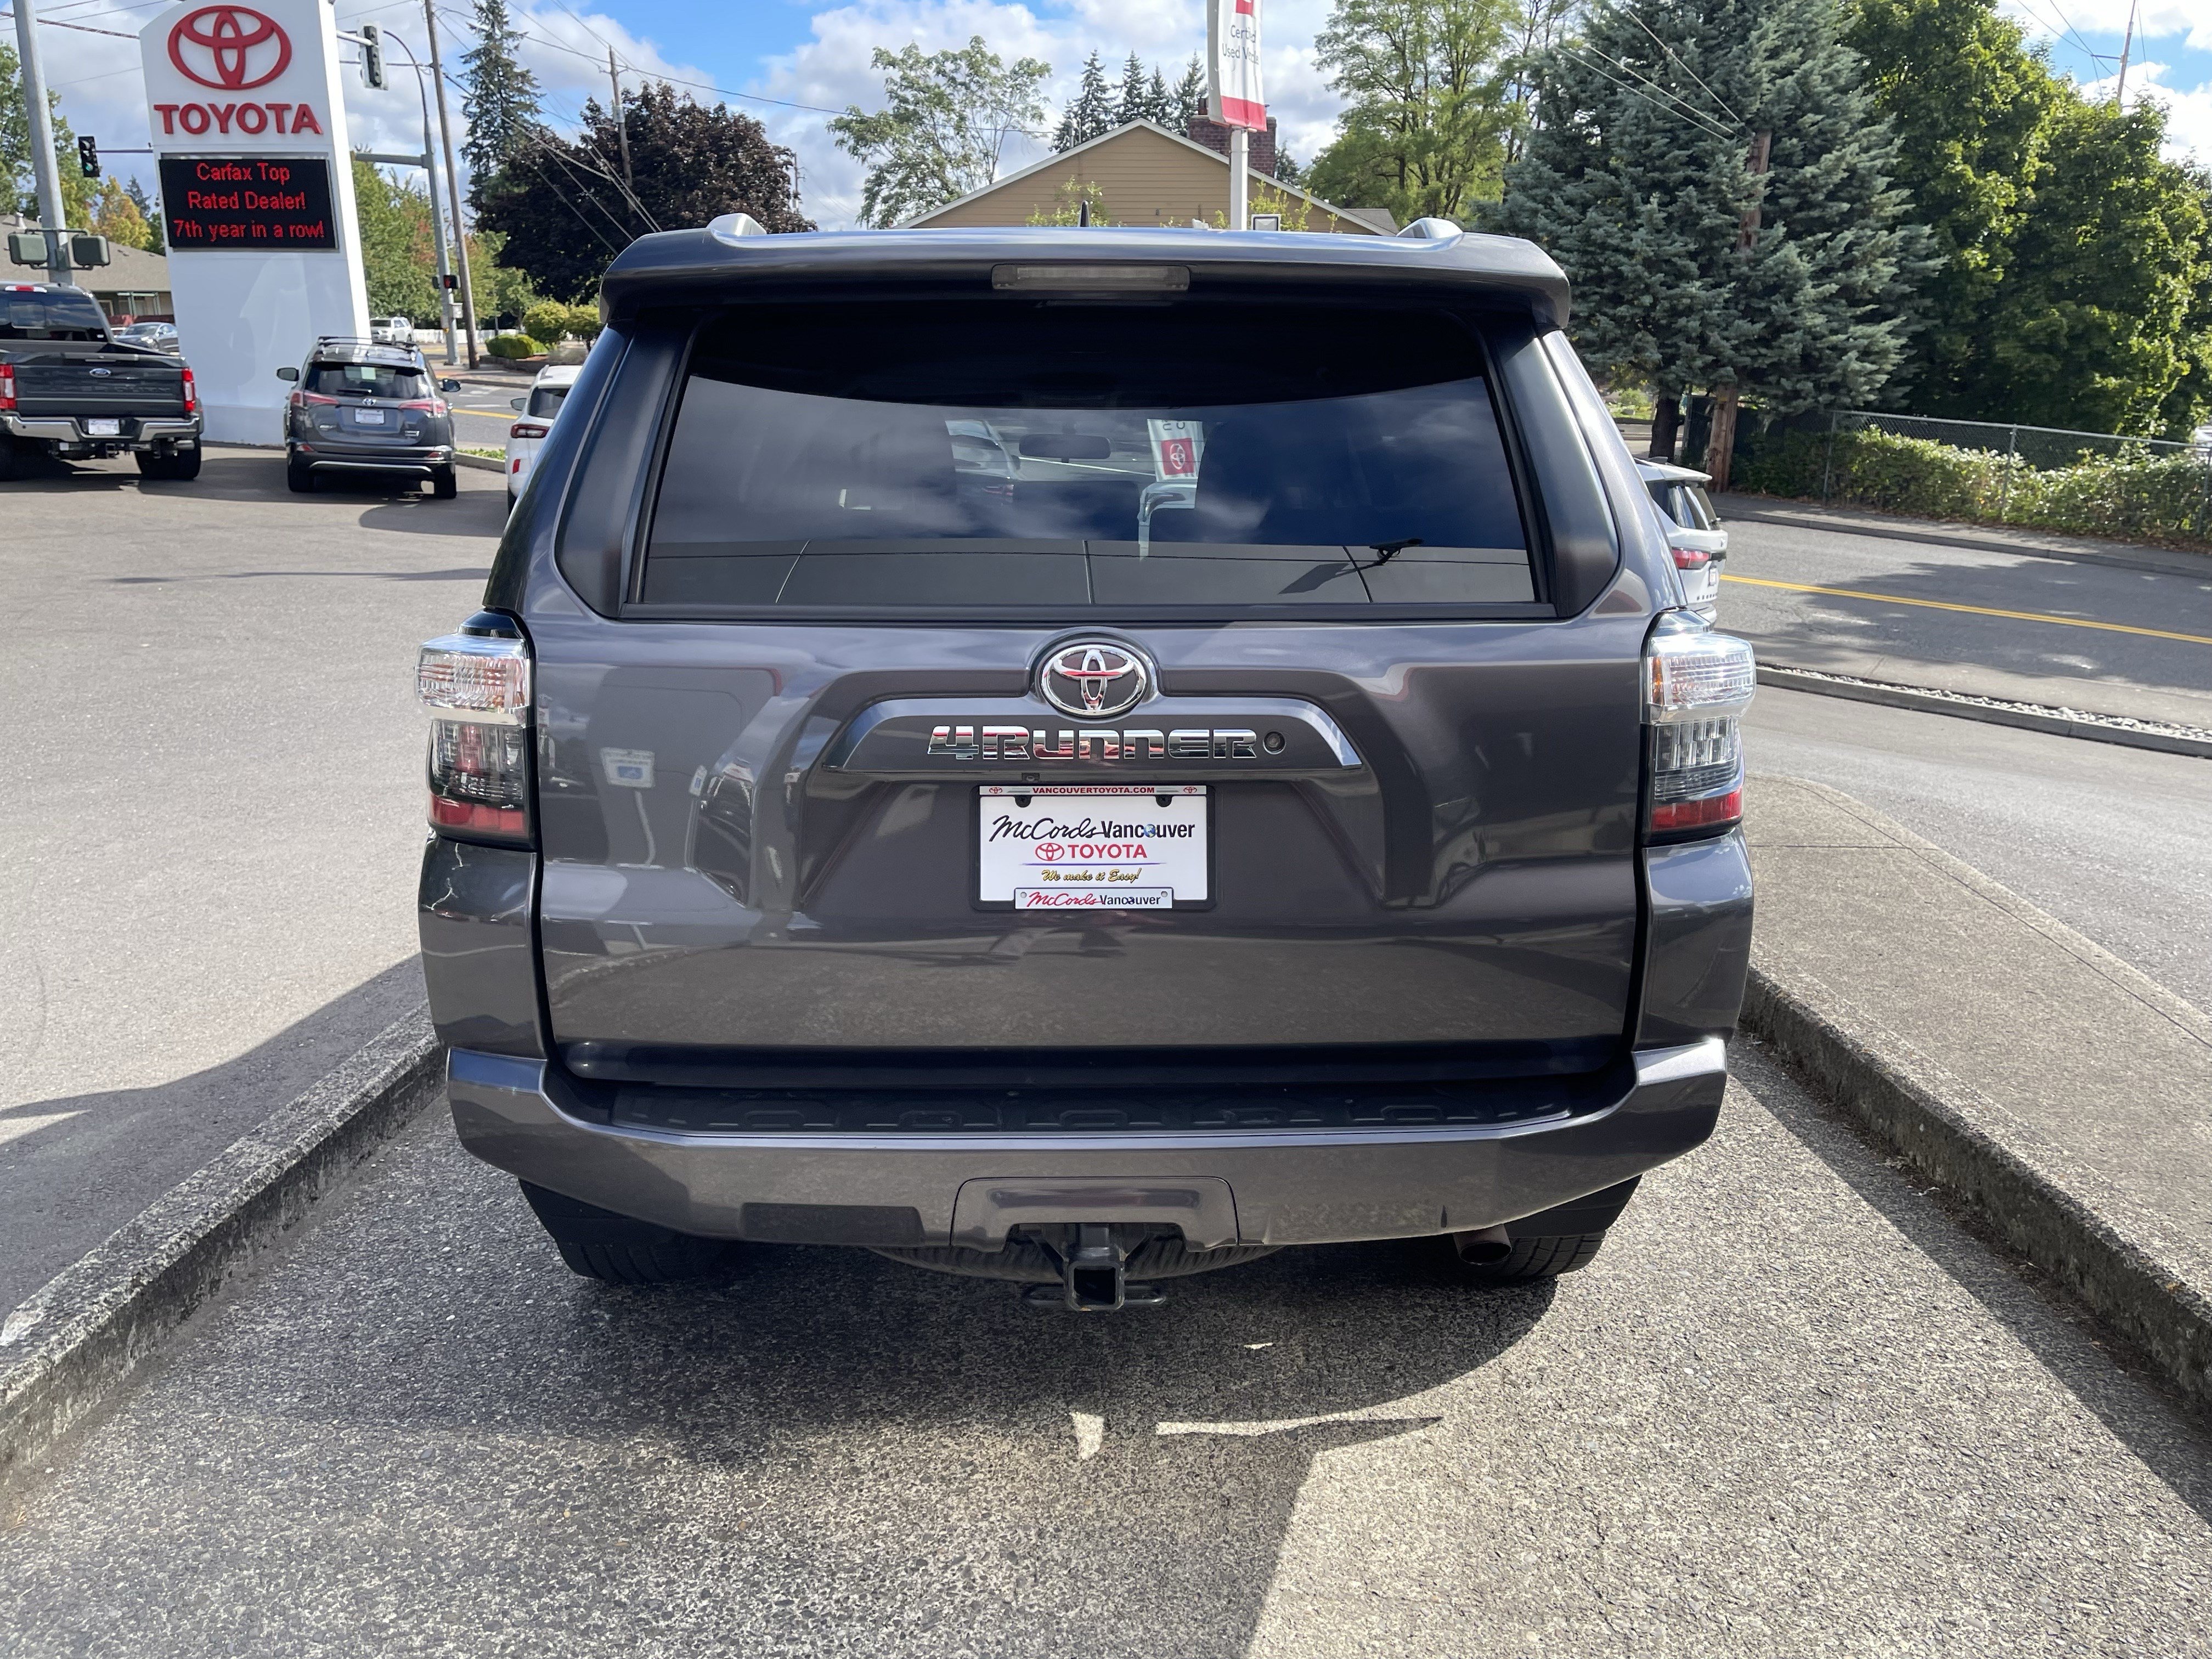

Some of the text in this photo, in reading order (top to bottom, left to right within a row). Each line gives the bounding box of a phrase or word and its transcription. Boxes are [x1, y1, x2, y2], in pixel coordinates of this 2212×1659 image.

[1222, 43, 1240, 59] Used
[154, 103, 324, 134] TOYOTA
[196, 162, 290, 185] Carfax Top
[188, 191, 306, 210] Rated Dealer!
[173, 219, 325, 242] 7th year in a row!
[989, 815, 1101, 842] McCords
[1068, 844, 1148, 859] TOYOTA
[1041, 867, 1142, 883] We make it Easy!
[1026, 891, 1101, 907] McCords
